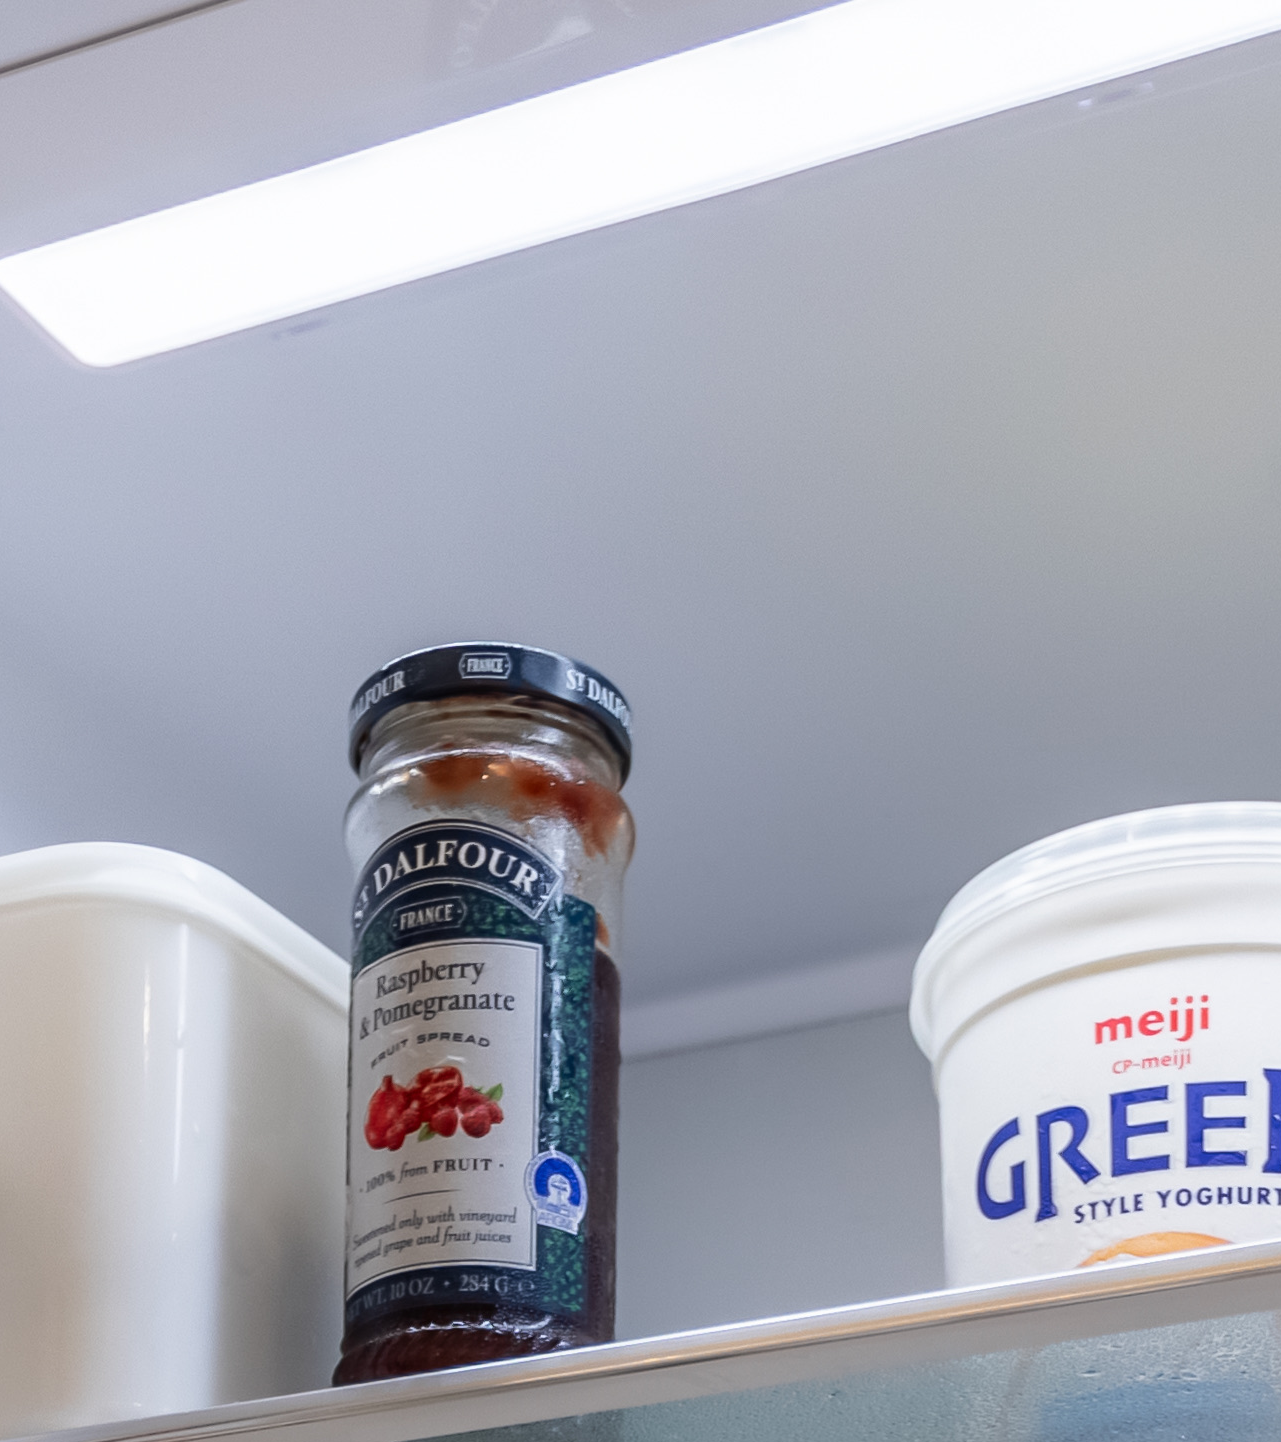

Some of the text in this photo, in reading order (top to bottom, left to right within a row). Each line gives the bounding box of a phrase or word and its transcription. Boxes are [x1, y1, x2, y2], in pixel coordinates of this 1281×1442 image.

[372, 839, 539, 897] DALFOUR
[398, 903, 455, 931] FRANCE
[375, 960, 485, 999] Raspberry
[359, 992, 516, 1040] & Pomegranate
[1094, 994, 1211, 1045] meiji
[370, 1032, 491, 1068] FRUIT SPREAD
[1111, 1049, 1193, 1075] CP-meiji
[365, 1157, 493, 1193] 100% from FRUIT
[398, 1209, 424, 1230] only
[427, 1205, 456, 1224] with
[459, 1206, 518, 1228] vineyard
[1073, 1192, 1145, 1224] STYLE
[416, 1225, 512, 1247] and fruit juices
[408, 1273, 490, 1297] OZ 284
